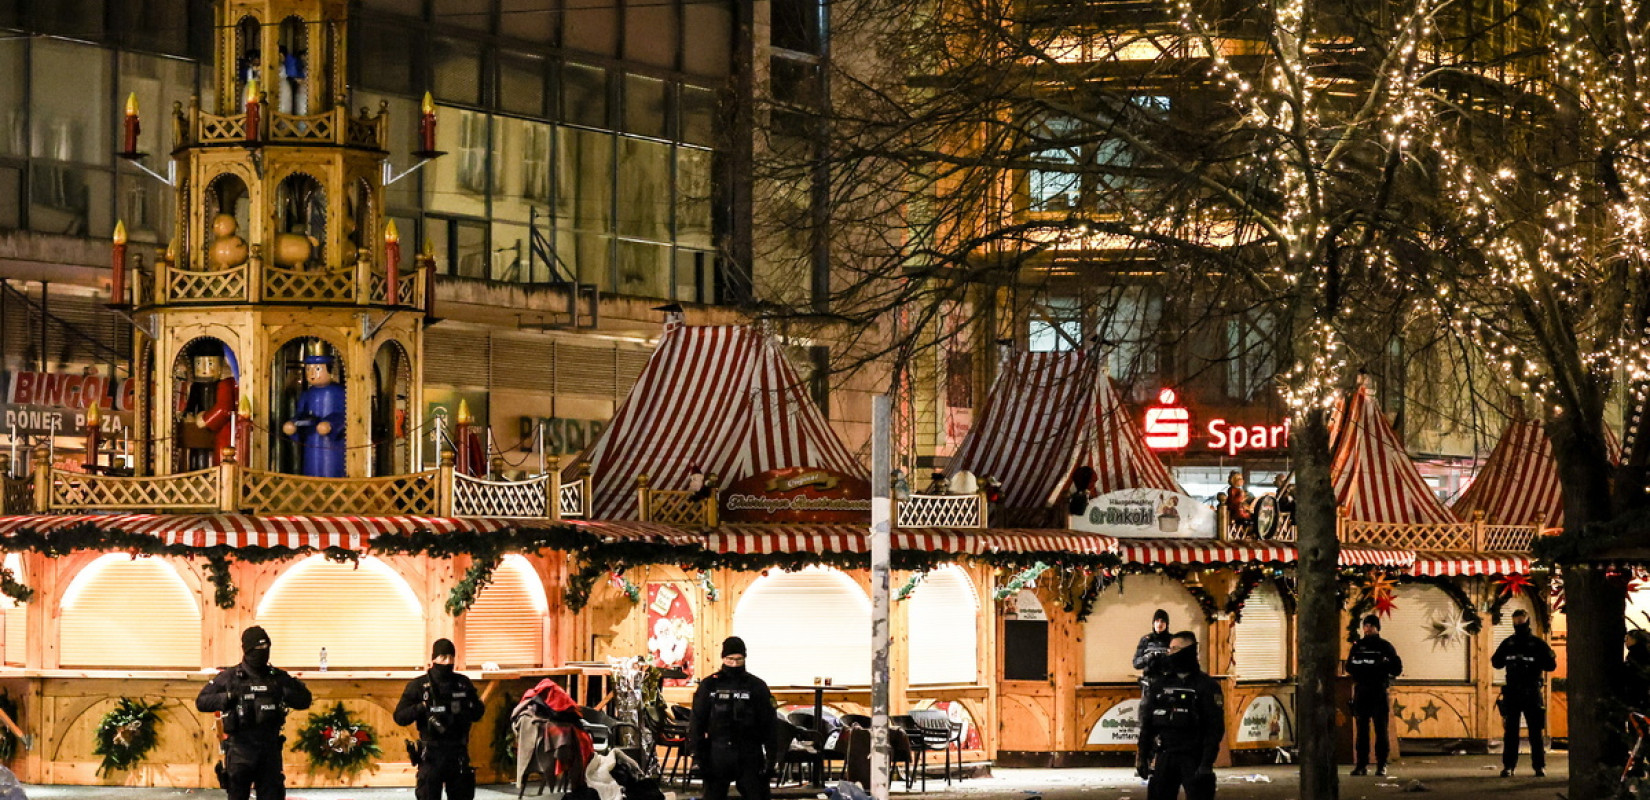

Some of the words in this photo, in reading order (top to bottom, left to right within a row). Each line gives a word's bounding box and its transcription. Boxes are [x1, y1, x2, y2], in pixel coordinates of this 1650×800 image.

[6, 406, 63, 430] DÖNER
[75, 414, 122, 432] PZA
[1089, 506, 1154, 525] Grünkohl
